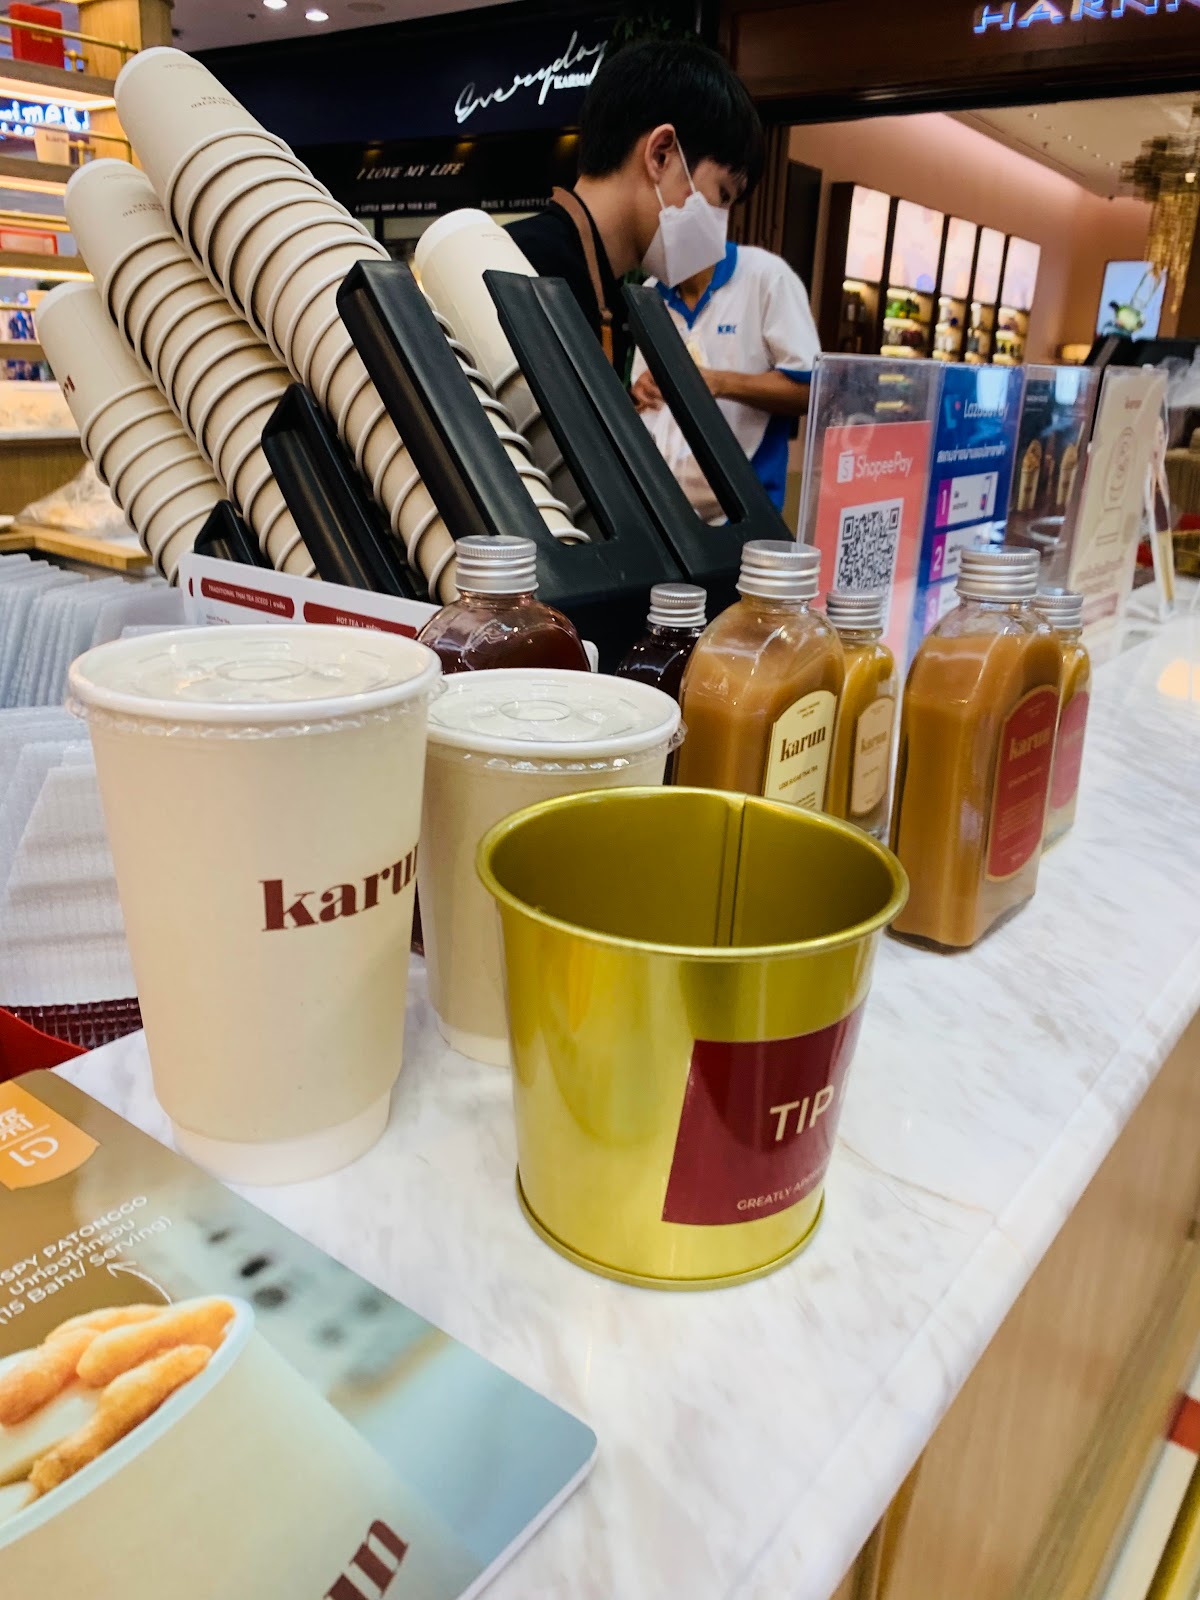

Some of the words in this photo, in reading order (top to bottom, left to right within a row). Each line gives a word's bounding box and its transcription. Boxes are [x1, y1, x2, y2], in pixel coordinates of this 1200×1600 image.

[454, 30, 608, 124] Everyday
[357, 168, 366, 180] I
[366, 166, 402, 180] LOVE
[404, 164, 430, 178] MY
[430, 162, 465, 176] LIFE
[855, 450, 914, 482] ShopeePay
[932, 545, 943, 572] 2
[208, 584, 236, 597] TRADITIONAL
[235, 591, 246, 600] THAI
[246, 594, 254, 603] TEA
[336, 616, 347, 625] HOT
[780, 726, 826, 763] karun
[258, 842, 419, 932] karu
[769, 1084, 835, 1142] TIP
[737, 1184, 792, 1211] GREATLY
[0, 1254, 39, 1286] SPY
